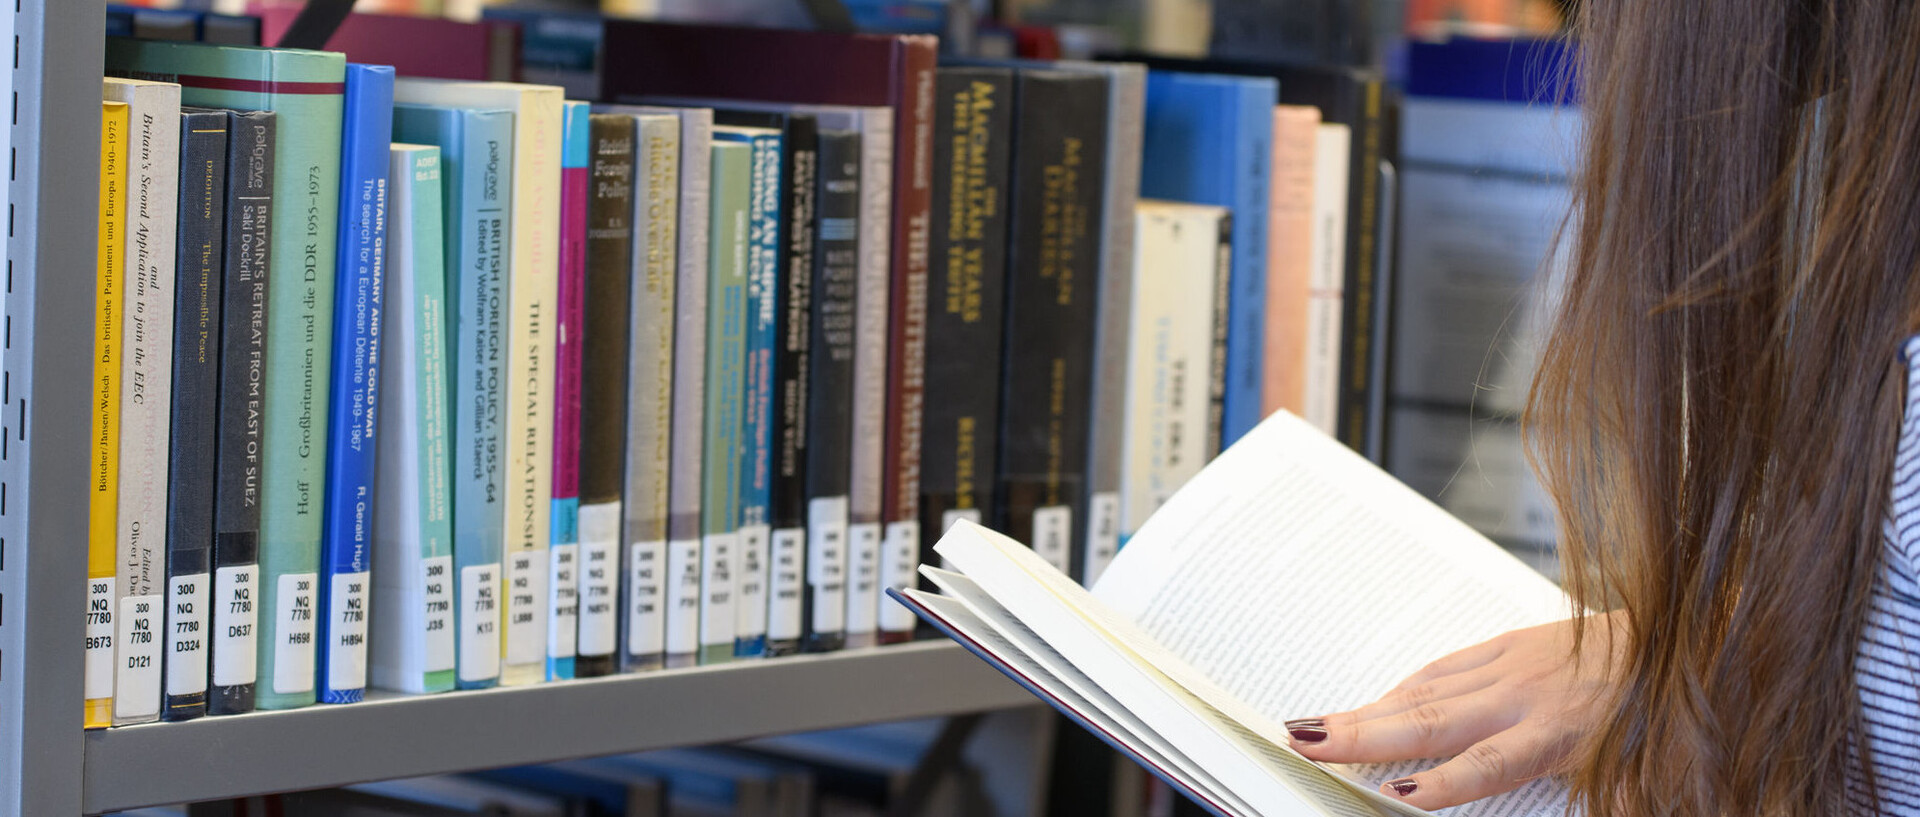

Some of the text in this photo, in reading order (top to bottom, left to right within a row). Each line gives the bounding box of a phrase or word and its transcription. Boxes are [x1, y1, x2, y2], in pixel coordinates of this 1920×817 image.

[253, 125, 267, 189] palgrave
[487, 141, 498, 200] palgrave
[763, 139, 780, 212] LOSING
[204, 160, 213, 219] DEIGHTON
[363, 179, 373, 200] The
[106, 180, 116, 217] Europa
[106, 221, 114, 240] und
[361, 203, 372, 243] search
[762, 216, 777, 245] AN
[239, 205, 254, 282] Saki Dockrill
[490, 220, 501, 281] BRITISH
[134, 113, 154, 405] Britain's Second Application to join the EEC
[305, 244, 317, 283] DDR
[359, 247, 370, 263] for
[104, 243, 113, 295] Parlament
[150, 265, 160, 290] and
[360, 266, 367, 274] a
[198, 241, 211, 363] The Impossible Peace
[304, 287, 315, 310] die
[356, 276, 369, 334] European
[365, 179, 385, 438] BRITAIN, GERMANY AND THE COLD WAR
[103, 299, 112, 340] britische
[489, 287, 499, 361] FOREIGN
[529, 300, 540, 339] THE
[303, 314, 314, 343] und
[103, 344, 111, 363] Das
[244, 205, 267, 507] BRITAIN'S RETREAT FROM EAST OF SUEZ
[473, 219, 487, 481] Edited by Wolfram Kaiser and Gillian Staerck
[354, 338, 367, 384] Détente
[527, 344, 539, 422] SPECIAL
[299, 348, 313, 459] Großbritannien
[486, 367, 499, 430] POLICY,
[297, 480, 309, 515] Hoff
[357, 486, 366, 499] R.
[355, 502, 366, 542] Gerald
[128, 521, 141, 572] Oliver J.
[141, 548, 151, 583] Edited
[426, 565, 443, 576] 300
[235, 573, 249, 582] 300
[297, 581, 309, 591] 300
[479, 573, 491, 583] 300
[92, 584, 107, 594] 300
[177, 584, 195, 595] 300
[234, 588, 249, 600] NQ
[348, 583, 361, 593] 300
[426, 584, 442, 595] NQ
[478, 587, 492, 598] NQ
[91, 598, 108, 611] NQ
[135, 603, 149, 613] 300
[177, 603, 193, 614] NQ
[230, 601, 252, 613] 7780
[296, 597, 309, 607] NQ
[347, 598, 361, 609] NQ
[426, 601, 449, 613] 7780
[475, 600, 494, 611] 7780
[87, 612, 111, 625] 7780
[291, 609, 310, 621] 7780
[342, 611, 363, 623] 7780
[134, 618, 149, 631] NQ
[176, 621, 199, 633] 7780
[228, 624, 252, 638] D637
[426, 619, 443, 631] J35
[86, 636, 112, 649] B673
[130, 631, 152, 644] 7780
[176, 640, 200, 652] D324
[288, 633, 310, 645] H698
[341, 634, 363, 646] H894
[128, 656, 150, 668] D121
